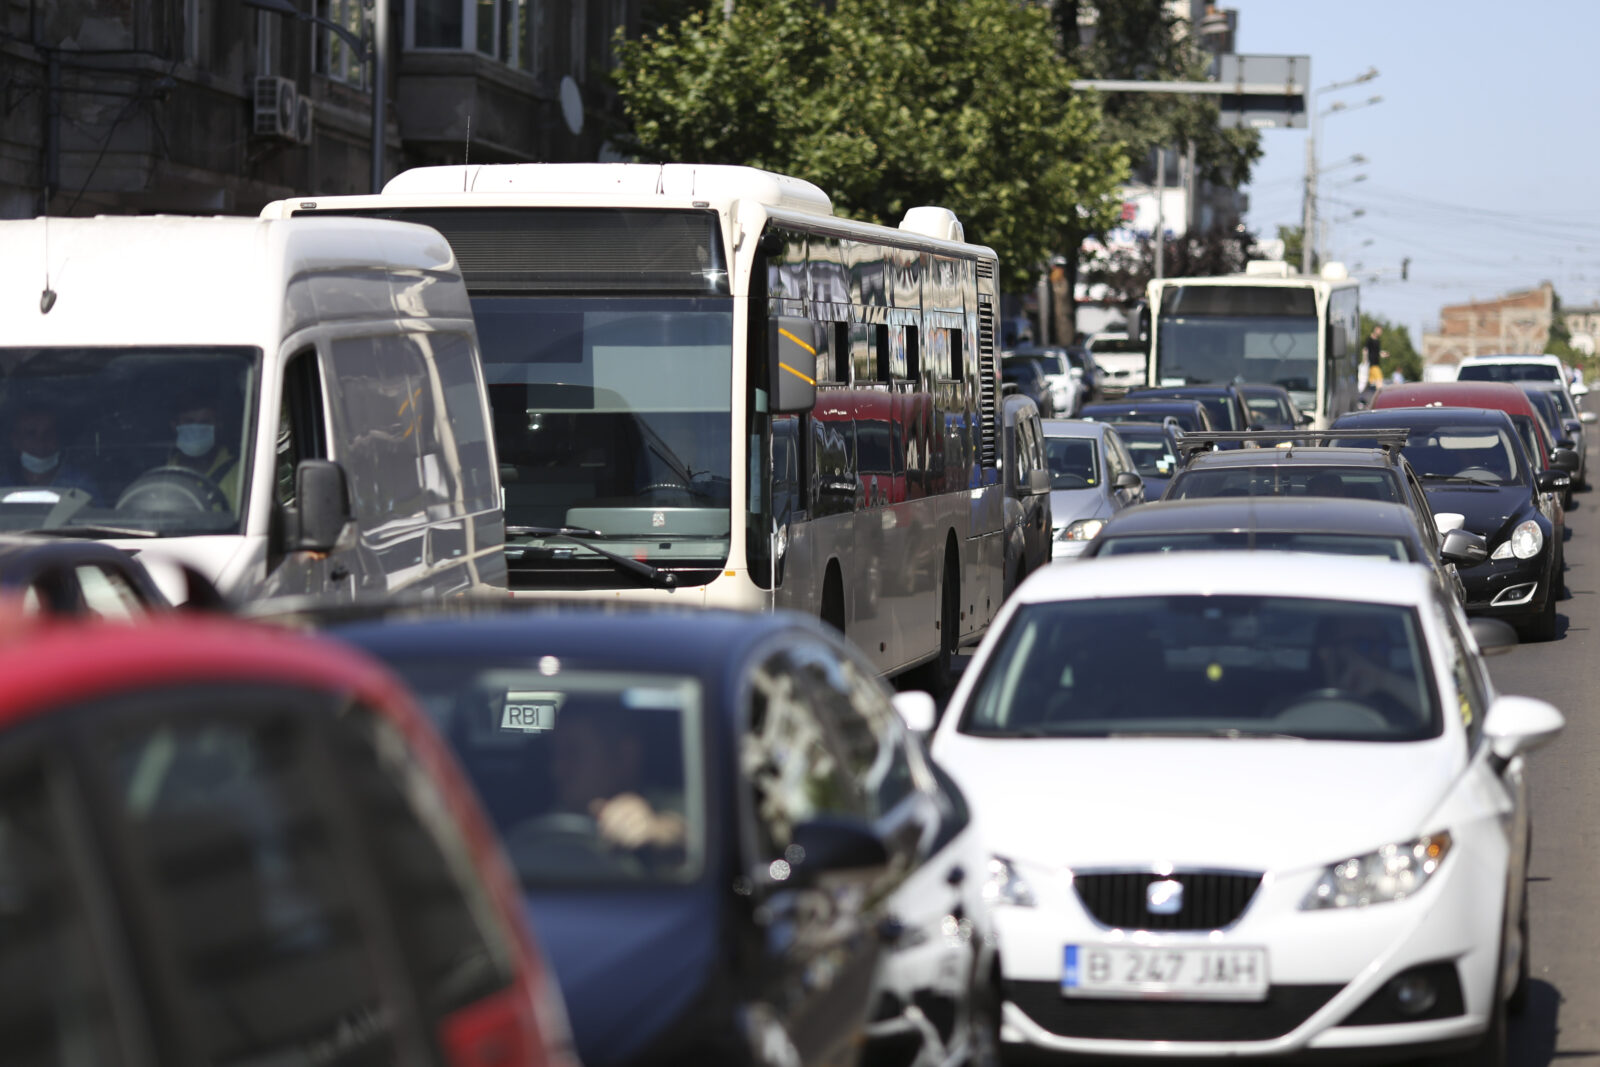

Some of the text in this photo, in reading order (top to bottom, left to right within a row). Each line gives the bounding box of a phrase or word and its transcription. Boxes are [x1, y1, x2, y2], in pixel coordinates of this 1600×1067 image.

[1089, 951, 1257, 985] B 247 JAH
